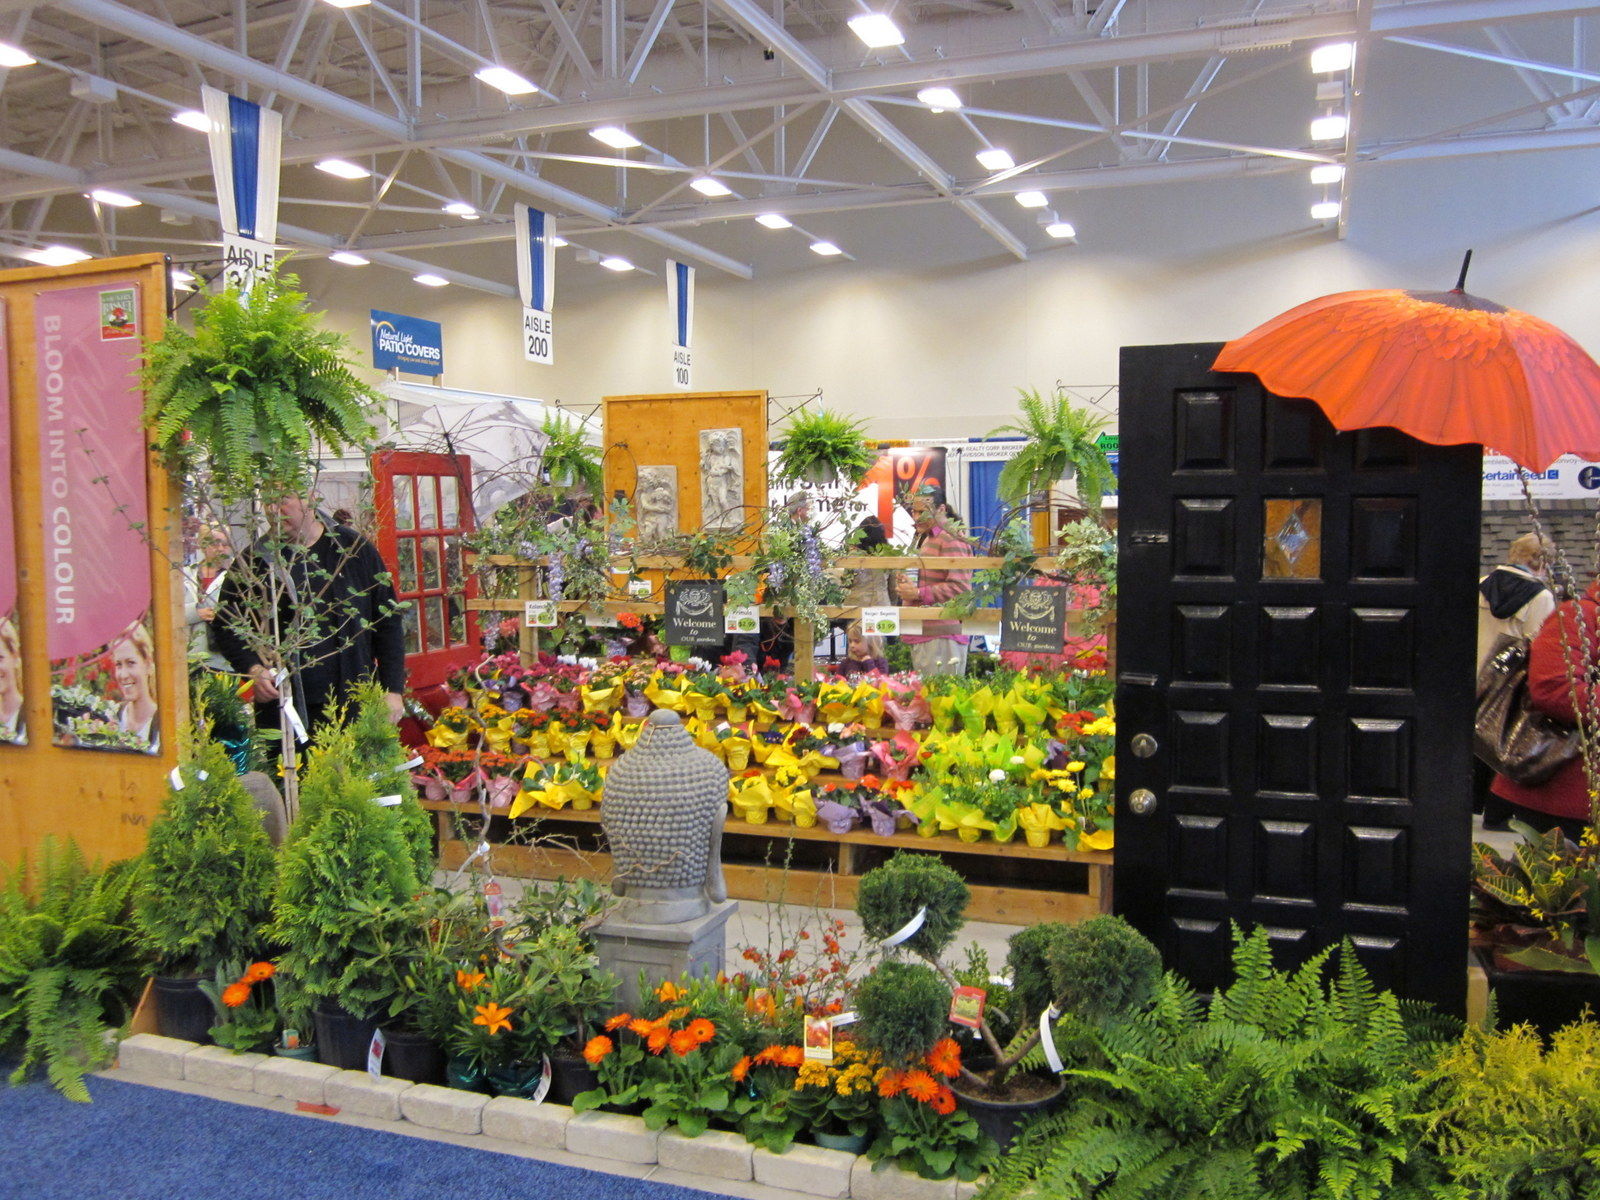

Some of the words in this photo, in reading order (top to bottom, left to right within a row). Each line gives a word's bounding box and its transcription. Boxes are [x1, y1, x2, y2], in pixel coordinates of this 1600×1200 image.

[226, 245, 273, 272] AISLE
[525, 315, 551, 335] AISLE
[380, 328, 401, 342] Natural
[400, 332, 413, 345] Light
[528, 335, 548, 357] 200
[379, 338, 405, 354] PATIO
[405, 343, 440, 360] COVERS
[673, 350, 691, 366] AISLE
[44, 315, 64, 421] BLOOM
[676, 367, 689, 385] 100
[1100, 442, 1119, 450] ROO
[48, 430, 68, 499] INTO
[52, 506, 75, 624] COLOUR
[673, 617, 717, 629] Welcome
[689, 628, 699, 636] to
[1010, 621, 1057, 635] Welcome
